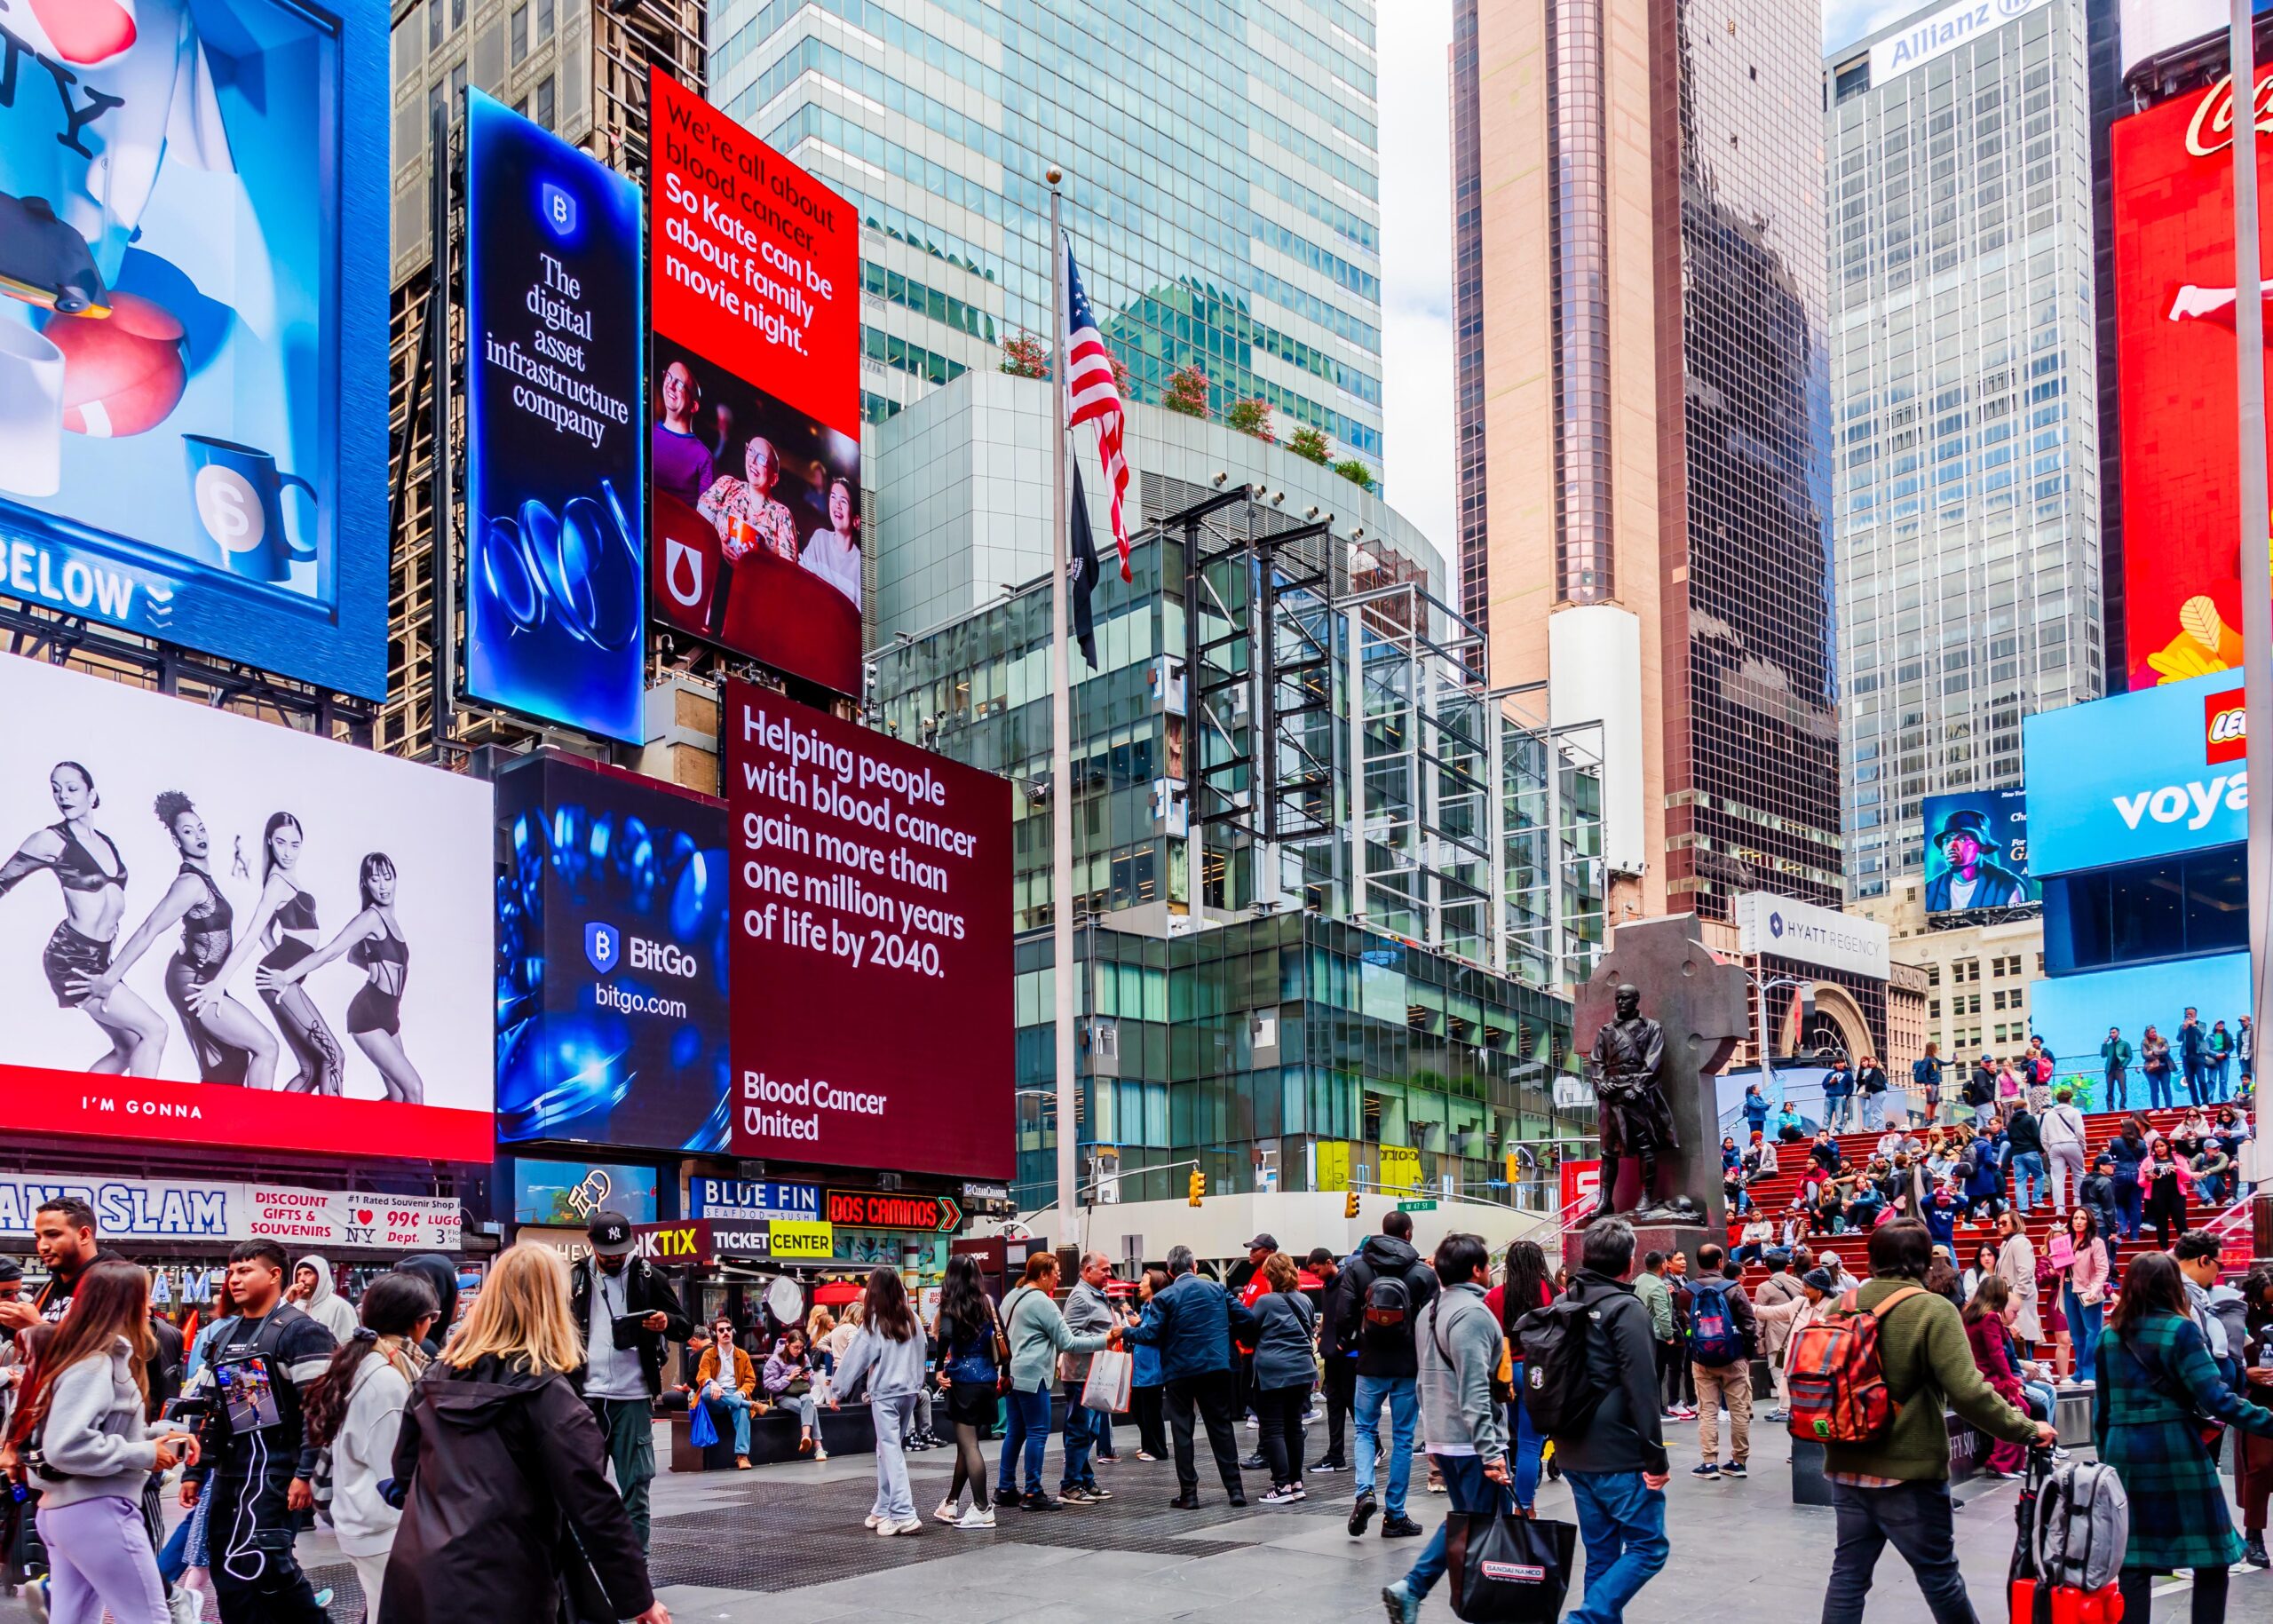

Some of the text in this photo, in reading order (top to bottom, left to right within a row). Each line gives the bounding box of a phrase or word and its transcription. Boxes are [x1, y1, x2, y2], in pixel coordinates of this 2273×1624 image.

[1891, 3, 1990, 68] Allianz
[665, 94, 836, 234] We're all about
[665, 133, 819, 257] blood cancer.
[665, 172, 833, 301] So Kate can be
[540, 252, 581, 301] The
[665, 218, 814, 329] about family
[527, 284, 592, 342] digital
[665, 255, 809, 357] movie night.
[535, 327, 586, 372] asset
[486, 332, 630, 424] infrastructure
[513, 382, 606, 448] company
[743, 703, 946, 807] Helping people
[742, 762, 978, 860] with blood cancer
[742, 812, 948, 893] gain more than
[743, 861, 966, 940] one million years
[630, 936, 697, 979] BitGo
[743, 902, 946, 978] of life by 2040.
[1787, 921, 1881, 957] HYATT REGENCY
[596, 982, 687, 1018] bitgo.com
[82, 1095, 203, 1120] I'M GONNA
[743, 1070, 887, 1116] Blood Cancer
[743, 1105, 820, 1142] United
[99, 1184, 227, 1235] SLAM
[255, 1192, 329, 1208] DISCOUNT
[263, 1208, 316, 1222] GIFTS &
[347, 1194, 360, 1204] #1
[363, 1196, 389, 1206] Rated
[392, 1198, 430, 1208] Souvenir
[432, 1200, 455, 1210] Shop
[705, 1180, 815, 1209] BLUE FIN
[706, 1208, 816, 1222] SEAFOOD SUSHI
[830, 1195, 937, 1227] DOS CAMINOS
[250, 1222, 332, 1238] SOUVENIRS
[345, 1227, 376, 1243] NY
[387, 1210, 420, 1227] 99¢
[387, 1232, 420, 1245] Dept.
[436, 1229, 445, 1244] 3
[713, 1231, 829, 1250] TICKET CENTER
[1486, 1565, 1514, 1573] BANDAI
